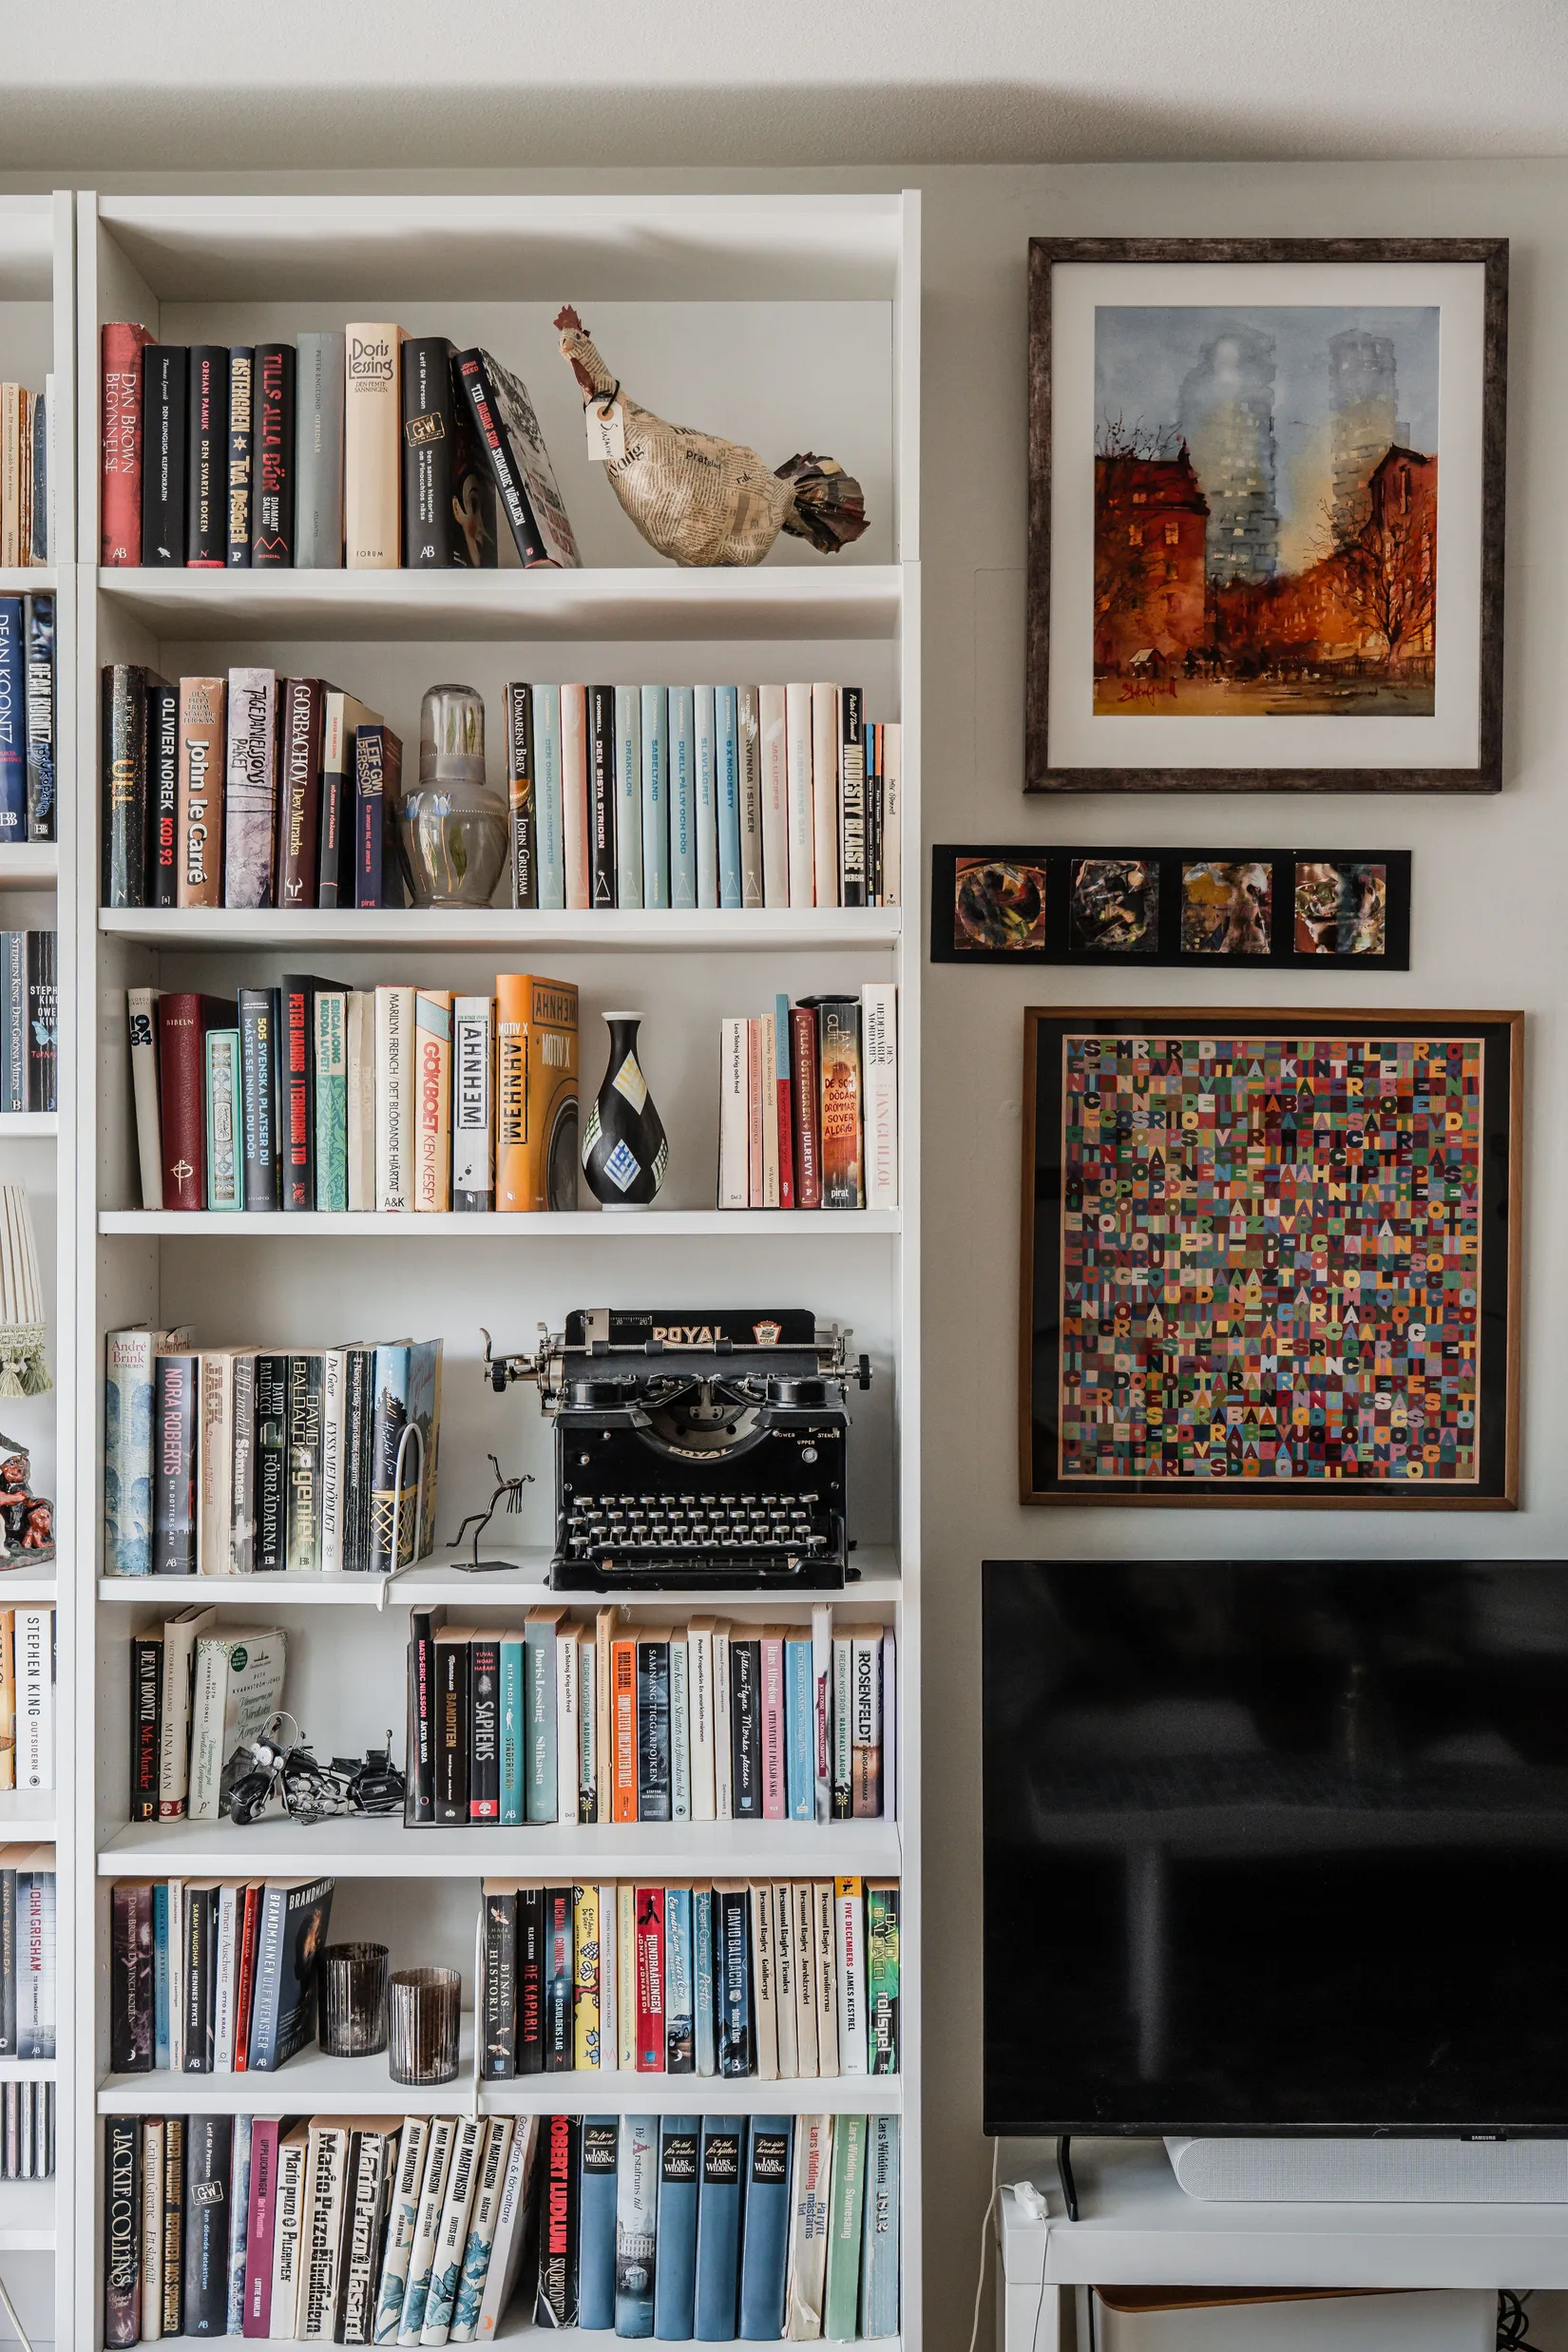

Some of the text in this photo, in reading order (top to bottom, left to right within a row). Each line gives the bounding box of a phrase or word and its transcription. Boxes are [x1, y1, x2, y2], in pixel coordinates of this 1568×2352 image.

[420, 370, 427, 378] GW
[471, 384, 485, 402] TIO
[105, 373, 120, 474] BEGYNNELSE
[122, 373, 136, 474] DAN BROWN
[230, 358, 251, 544] ÖSTERGREN TVÅ PISTOLER
[485, 430, 500, 448] SOM
[201, 463, 209, 497] SVARTA
[492, 448, 510, 487] SKAKADE
[506, 487, 525, 526] VÄRLDEN
[29, 663, 50, 695] DEAN
[29, 697, 51, 743] KOONTZ
[161, 698, 175, 865] OLIVIER NOREK KOD 93
[291, 686, 310, 856] GORBACHOV Dev Murarka
[514, 689, 529, 895] DOMARENS BREV JOHN GRISHAM
[187, 739, 211, 886] John le Carré
[597, 802, 605, 849] STRIDEN
[843, 744, 864, 870] MODESTY BLAISE
[11, 938, 23, 1089] STEPHEN KING DEN GRÖNA MILEN
[244, 1019, 256, 1056] MÅSTE
[290, 994, 304, 1072] PETER HARRIS
[320, 1000, 331, 1072] RÄDDA LIVET!
[331, 1000, 341, 1063] ERICA JONG
[245, 1059, 254, 1072] SE
[258, 1018, 268, 1165] 505 SVENSKA PLATSER DU
[246, 1115, 255, 1131] DU
[423, 1042, 440, 1203] GÖKBOET KEN KESEY
[800, 1029, 813, 1176] KLAS ÖSTERGREN JULREVY
[247, 1135, 257, 1158] DÖR
[653, 1326, 729, 1344] ROYAL
[165, 1368, 182, 1406] NORA
[259, 1363, 271, 1414] BALDACCI
[272, 1383, 283, 1414] DAVID
[164, 1411, 182, 1474] ROBERTS
[235, 1439, 248, 1504] Sömnen
[668, 1445, 734, 1459] ROYAL
[169, 1481, 175, 1490] EN
[263, 1454, 278, 1552] FÖRRÄDARNA
[768, 1646, 777, 1665] Hans
[768, 1667, 777, 1704] Alfredson
[28, 1617, 40, 1770] STEPHEN KING OUTSIDERN
[141, 1651, 155, 1788] DEAN KOONTZ Mr. Murder
[859, 1654, 870, 1743] ROSENFELDT
[164, 1723, 173, 1756] MINA
[476, 1701, 493, 1760] SAPIENS
[535, 1736, 545, 1784] Shikasta
[648, 1704, 658, 1782] TIGGARPOJKEN
[163, 1762, 174, 1789] MÄN
[29, 1884, 42, 1971] JOHN GRISHAM
[845, 1922, 853, 1967] DECEMBERS
[258, 1895, 280, 2049] BRANDMANNEN ULF KVENSLER
[489, 1950, 498, 2022] HISTORIA
[525, 1965, 537, 2041] DE KAPABLA
[646, 1935, 661, 2014] HUNDRAÅRINGEN
[874, 1992, 891, 2052] rollspel
[146, 2140, 158, 2218] Graham Greene
[258, 2139, 269, 2196] UPPLUCKRINGEN
[452, 2124, 476, 2203] MOA MARTINSON
[484, 2124, 504, 2189] MOA MARTINSON
[633, 2139, 650, 2194] Årstafruns
[806, 2127, 819, 2189] Lars Widding
[112, 2129, 132, 2286] JACKIE COLLINS
[502, 2176, 519, 2223] förvaltare
[549, 2182, 567, 2252] LUDLUM
[806, 2193, 816, 2239] mästarns
[876, 2190, 889, 2233] 1812
